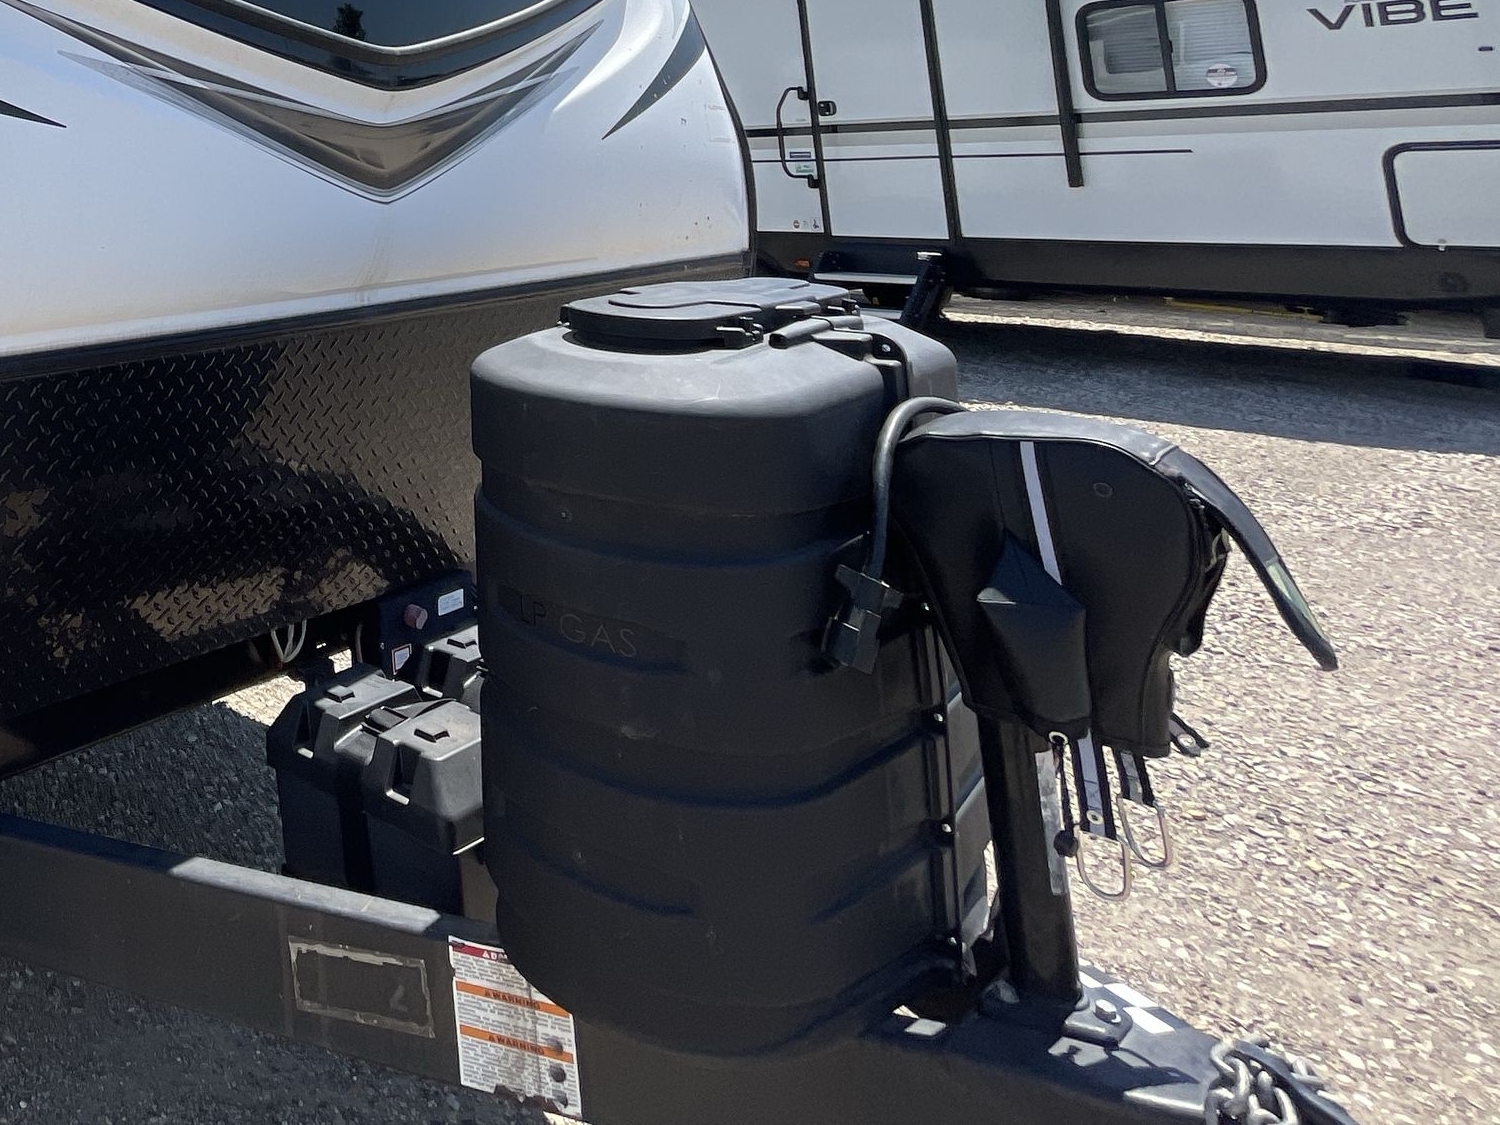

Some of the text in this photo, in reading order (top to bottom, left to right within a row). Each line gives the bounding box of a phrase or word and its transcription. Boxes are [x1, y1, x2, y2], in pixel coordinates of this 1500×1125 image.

[559, 613, 637, 658] GAS
[492, 991, 541, 1010] WARNING
[497, 1035, 546, 1056] WARNING
